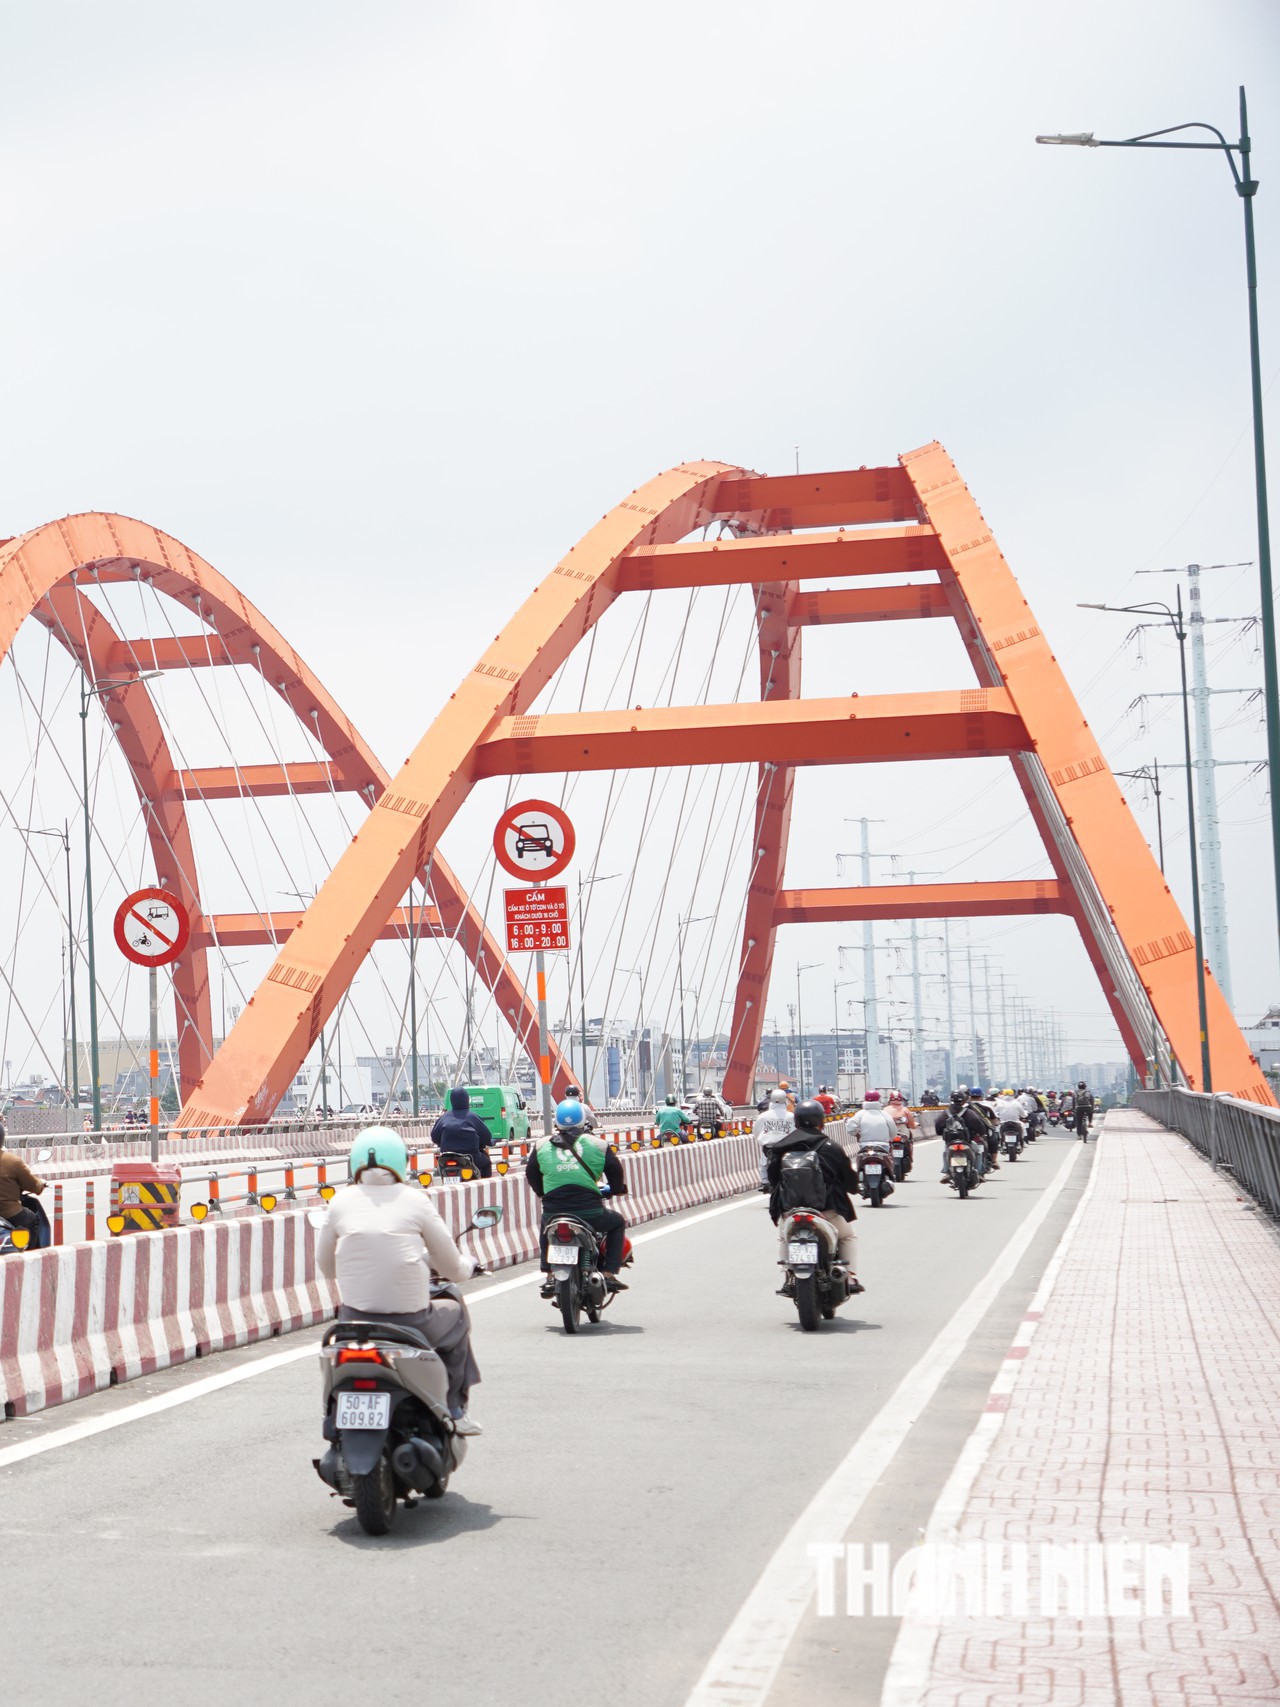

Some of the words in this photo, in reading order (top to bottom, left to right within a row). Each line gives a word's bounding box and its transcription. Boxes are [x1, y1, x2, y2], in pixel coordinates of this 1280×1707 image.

[526, 890, 545, 902] CẤM
[346, 1395, 382, 1410] 50-AF
[341, 1412, 384, 1427] 609.82
